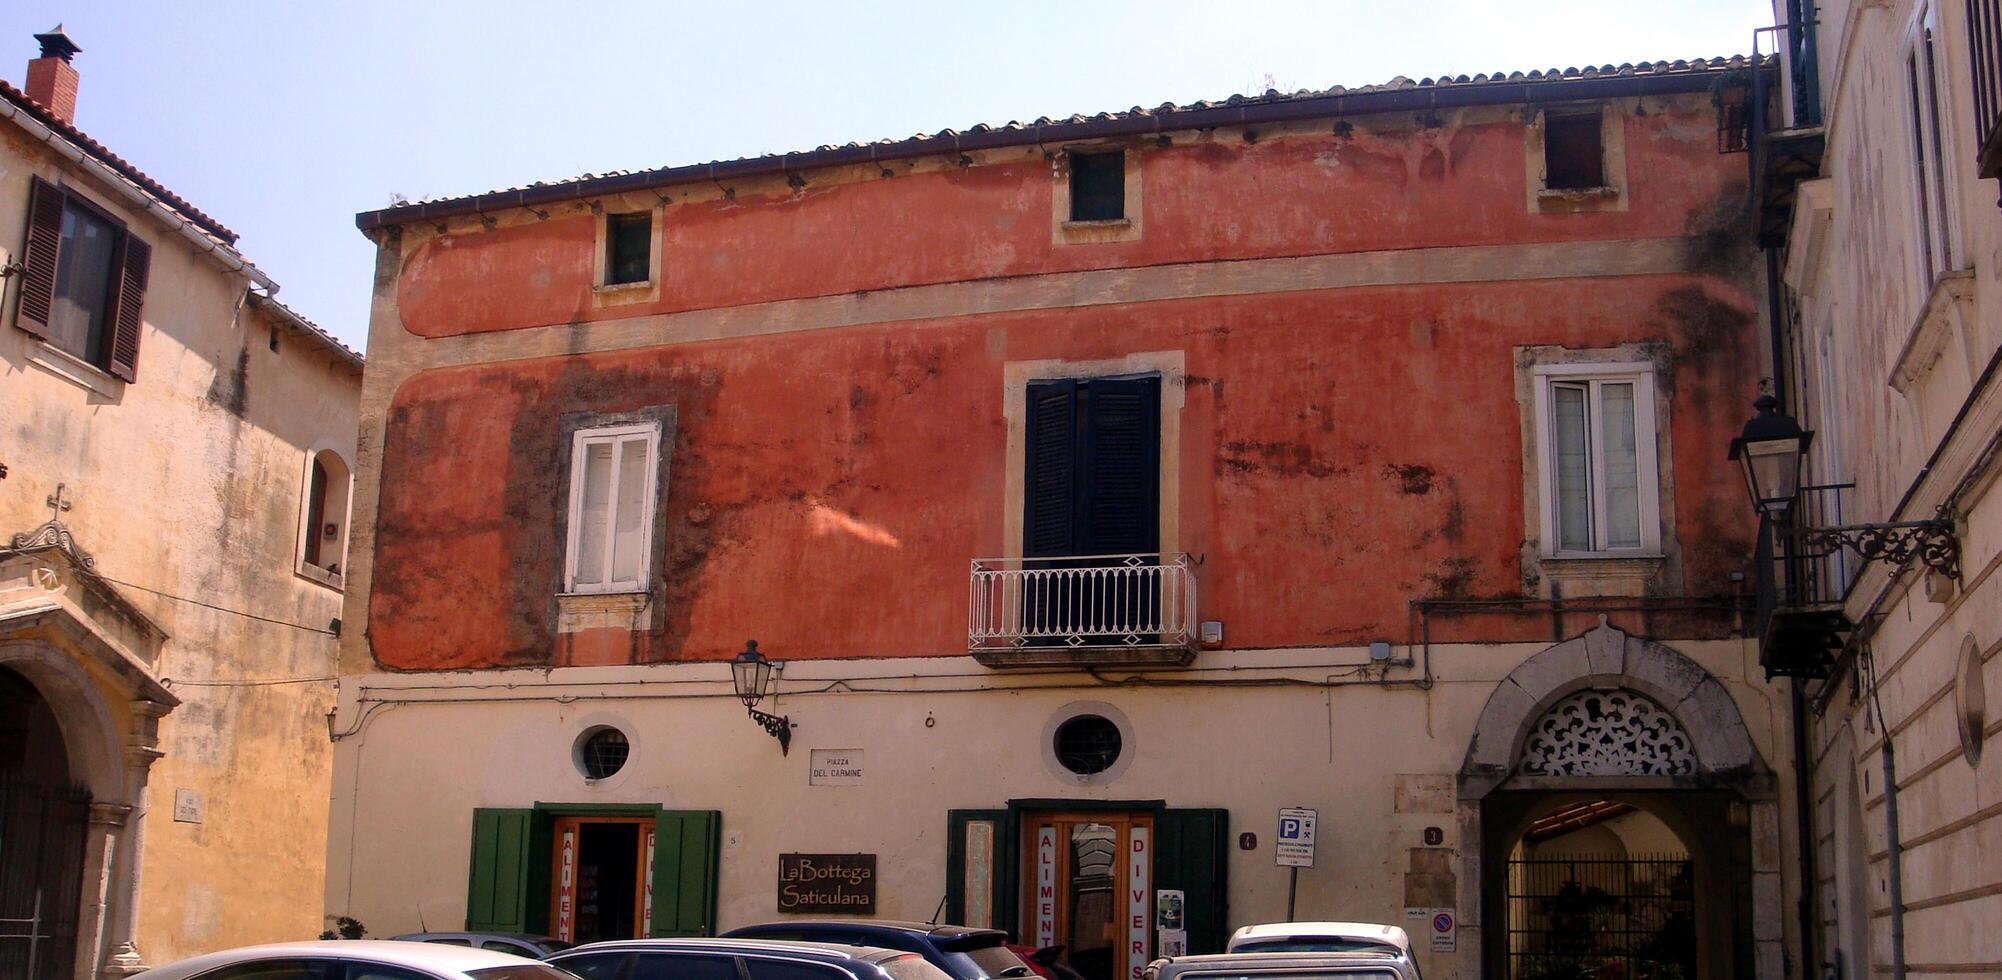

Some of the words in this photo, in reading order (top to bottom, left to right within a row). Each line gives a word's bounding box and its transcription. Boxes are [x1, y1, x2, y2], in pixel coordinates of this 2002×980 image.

[813, 769, 828, 777] DEL
[831, 769, 862, 777] CARMINE
[1283, 820, 1298, 837] P
[781, 885, 869, 907] Saticulana
